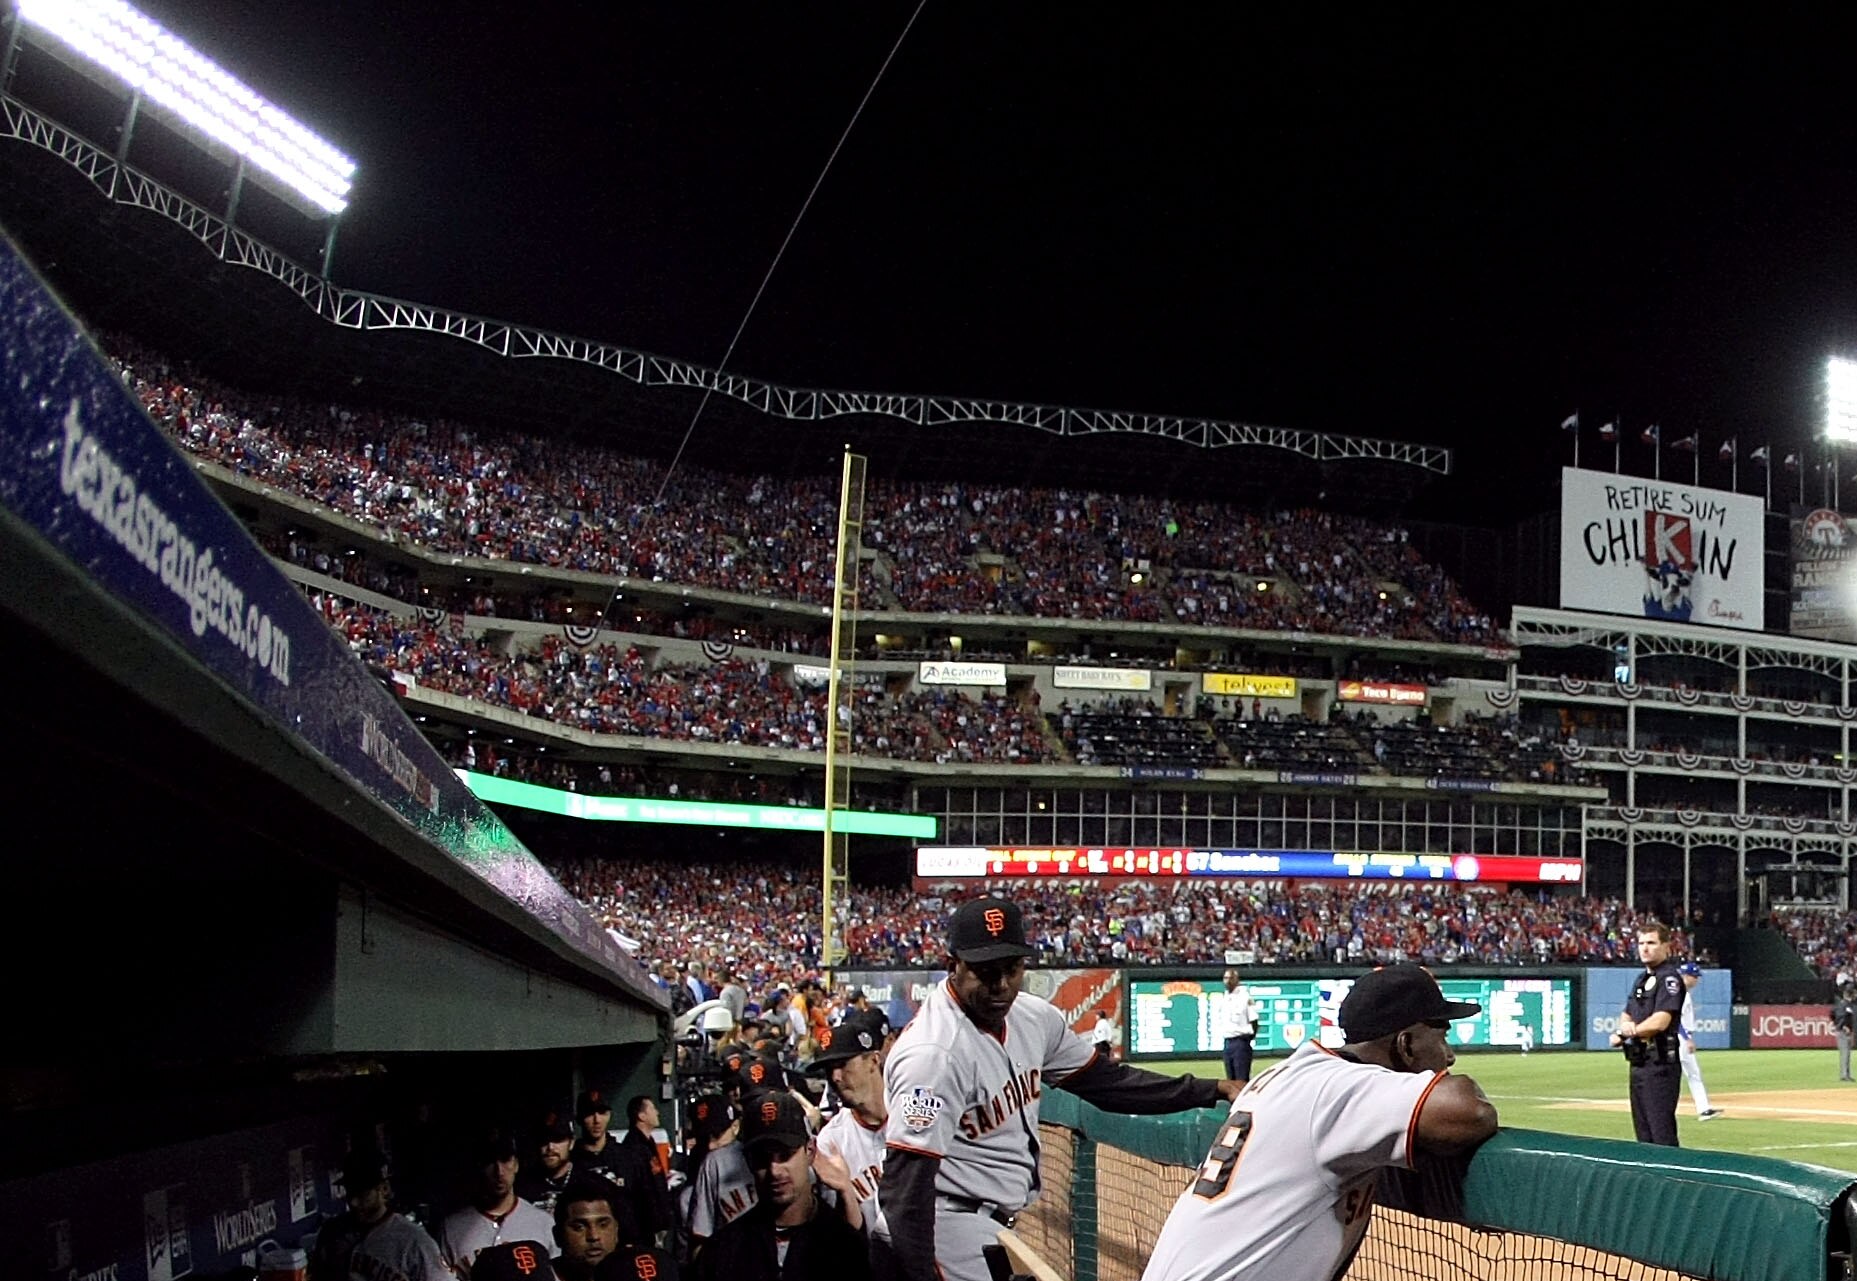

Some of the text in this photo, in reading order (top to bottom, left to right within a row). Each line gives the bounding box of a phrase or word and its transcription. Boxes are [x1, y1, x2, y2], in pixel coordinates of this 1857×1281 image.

[1605, 485, 1727, 528] RETIRE SUM
[61, 399, 290, 687] texasrangers.com
[942, 666, 1000, 677] Academy
[984, 908, 1004, 937] SF
[1752, 1016, 1837, 1037] JCPenne
[901, 1094, 942, 1110] WORLD
[903, 1106, 938, 1119] SERIES
[960, 1094, 1005, 1140] SAN
[512, 1245, 537, 1275] SF
